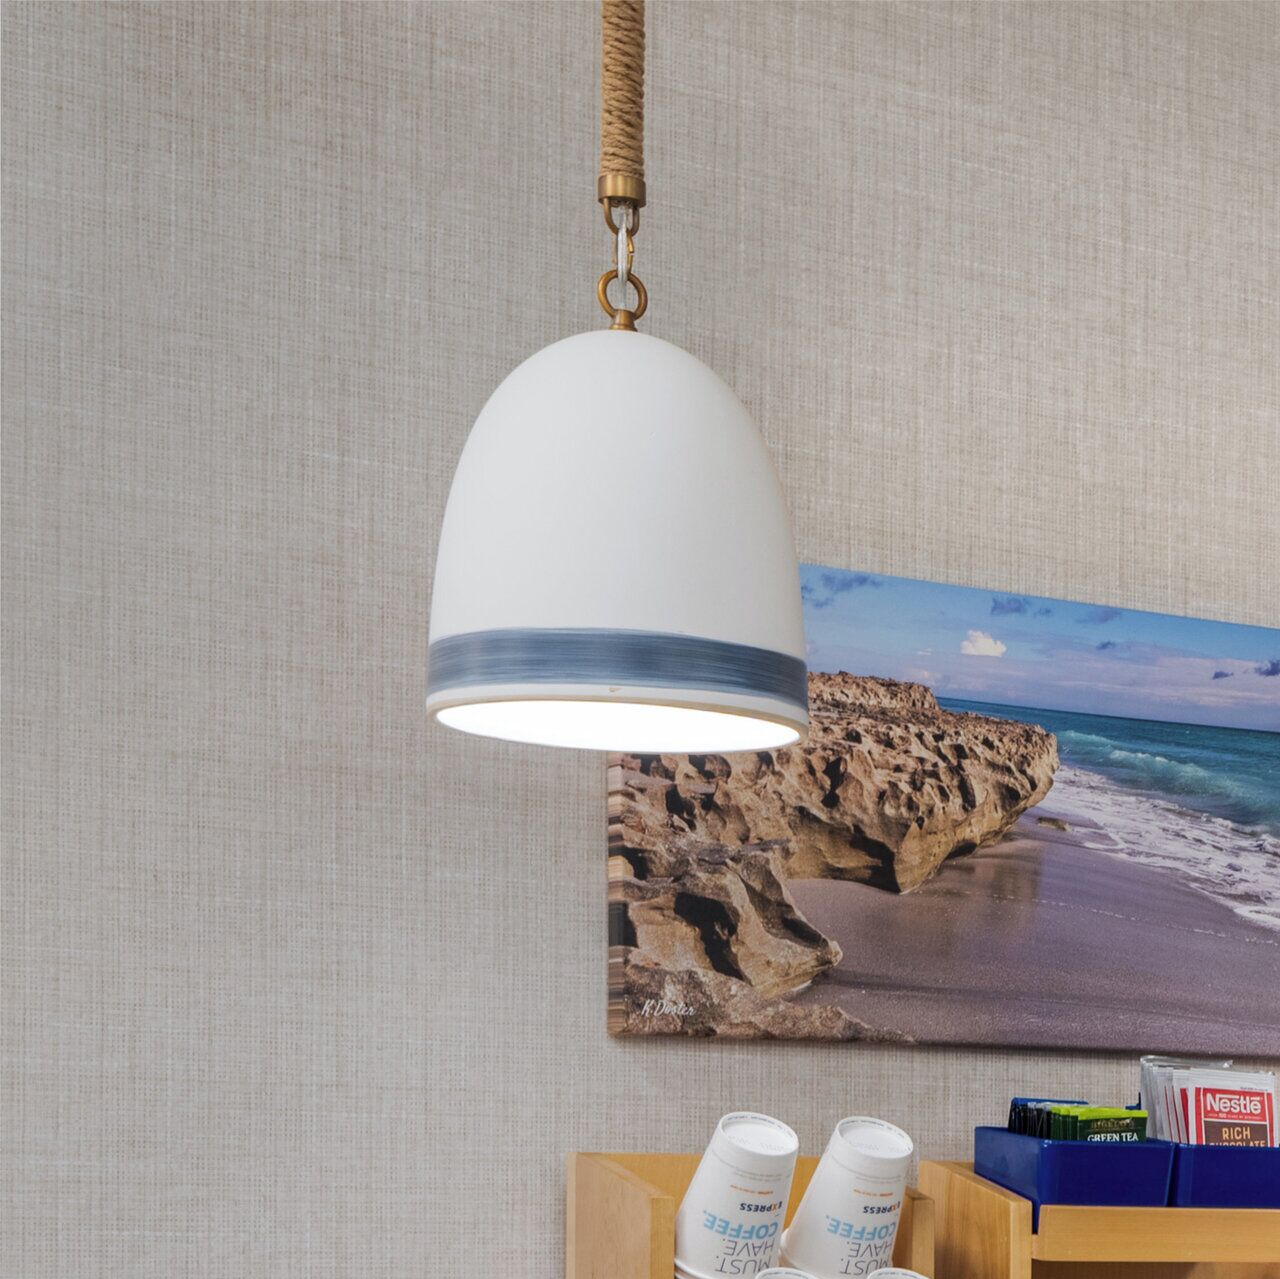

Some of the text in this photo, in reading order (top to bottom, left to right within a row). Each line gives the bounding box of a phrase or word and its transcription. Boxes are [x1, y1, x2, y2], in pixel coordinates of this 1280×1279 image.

[1121, 1132, 1140, 1142] TEA
[1222, 1127, 1251, 1141] RICH
[739, 1200, 783, 1213] EXPRESS
[702, 1210, 779, 1240] COFFEE.
[826, 1214, 897, 1241] COFFEE.
[722, 1238, 776, 1257] HAVE.
[714, 1255, 772, 1276] MUST.
